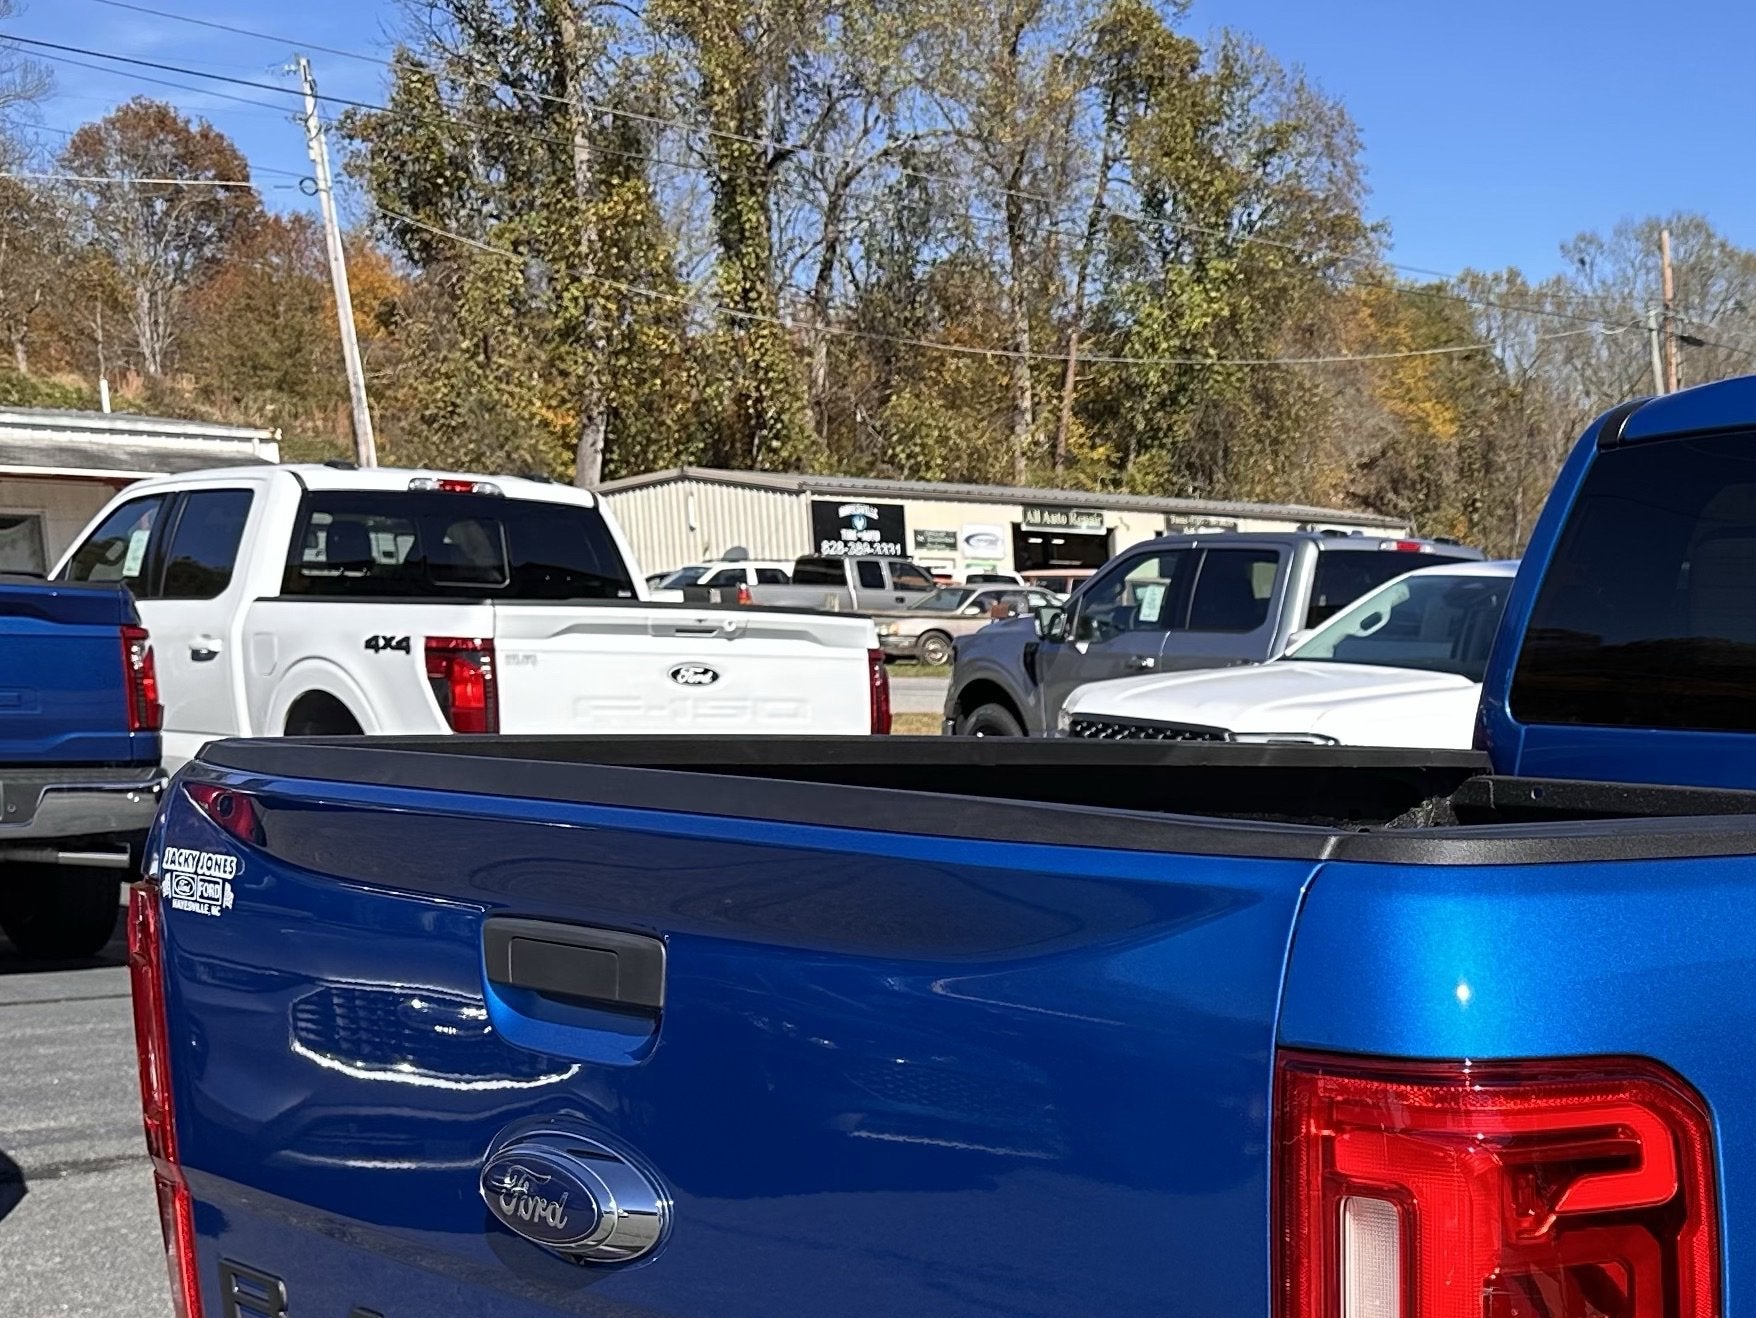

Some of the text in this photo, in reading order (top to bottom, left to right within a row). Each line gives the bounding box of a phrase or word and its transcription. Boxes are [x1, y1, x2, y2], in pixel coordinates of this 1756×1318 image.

[1026, 509, 1041, 524] All
[1042, 511, 1068, 526] Auto
[677, 666, 714, 685] Ford
[163, 847, 237, 879] JACKY JONES
[199, 881, 221, 899] FORD
[492, 1166, 569, 1230] Ford
